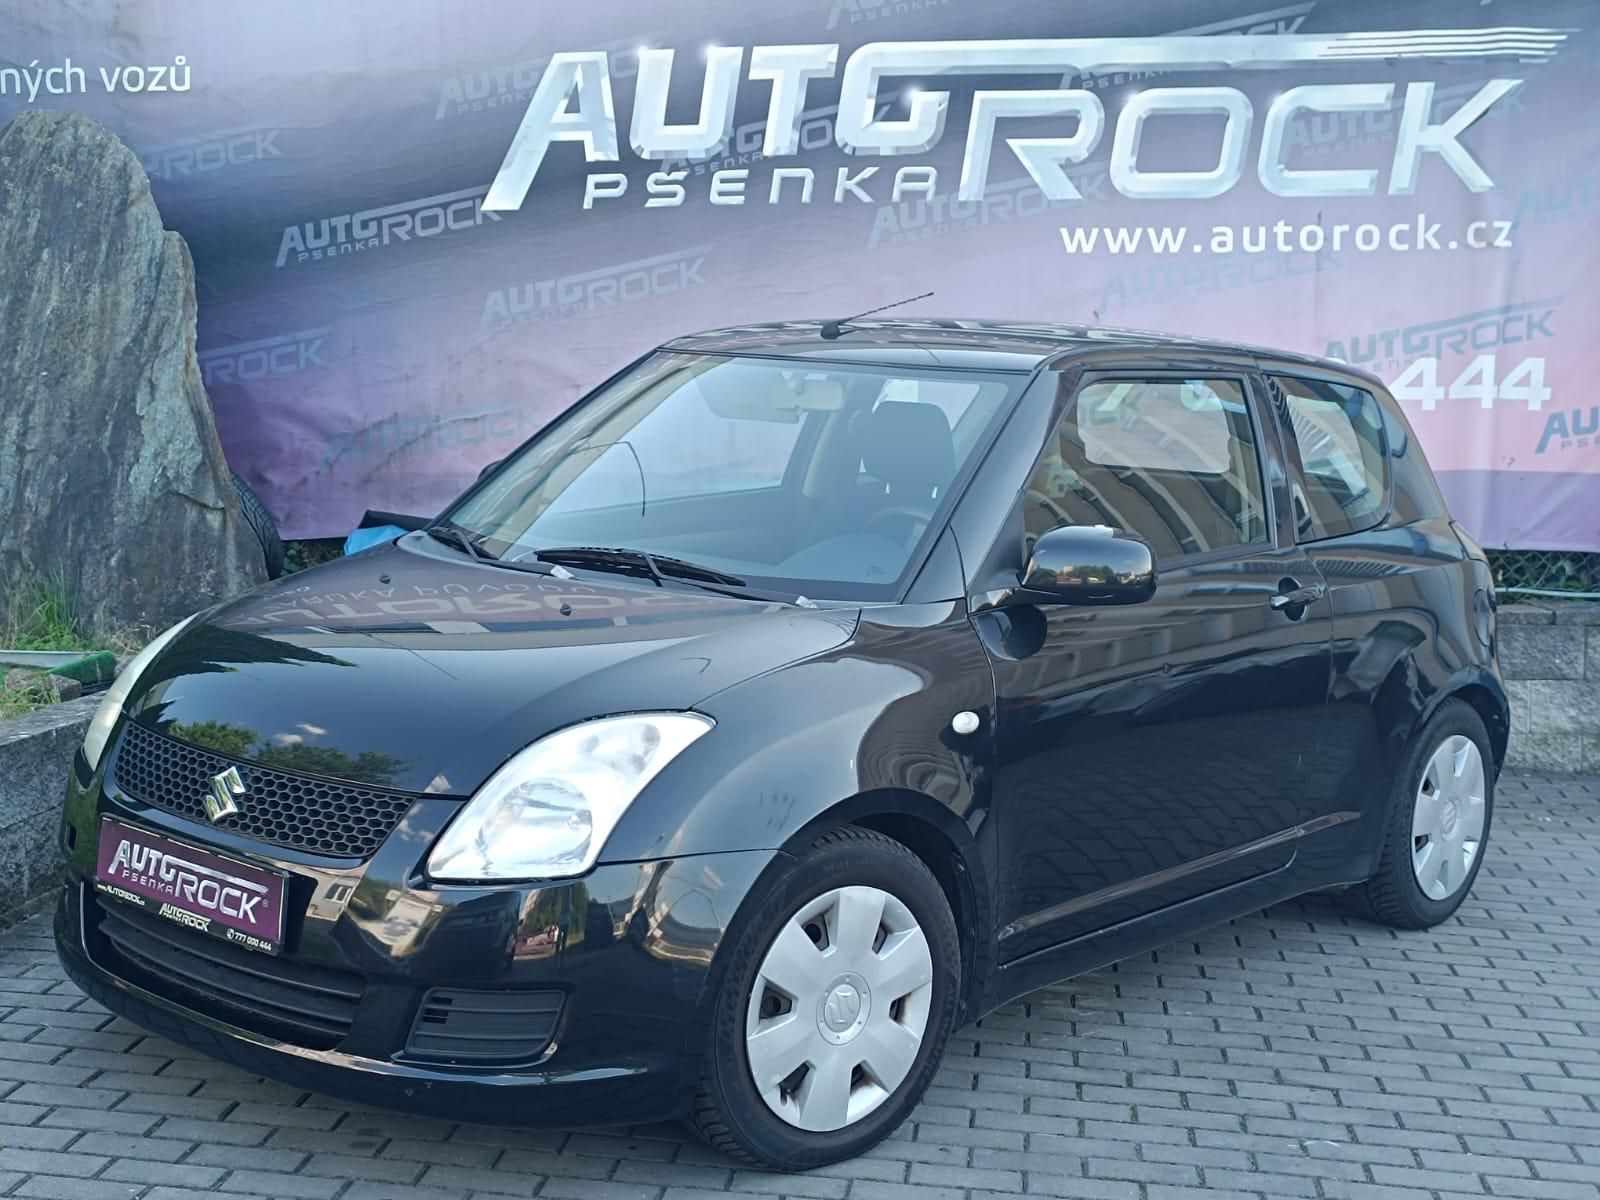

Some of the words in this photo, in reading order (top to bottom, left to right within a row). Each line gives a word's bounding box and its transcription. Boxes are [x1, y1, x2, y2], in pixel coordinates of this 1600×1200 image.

[0, 58, 86, 103] ných
[100, 55, 192, 94] vozů
[1060, 213, 1513, 255] www.autorock.cz
[199, 325, 332, 387] ROCK
[1389, 354, 1552, 412] 444
